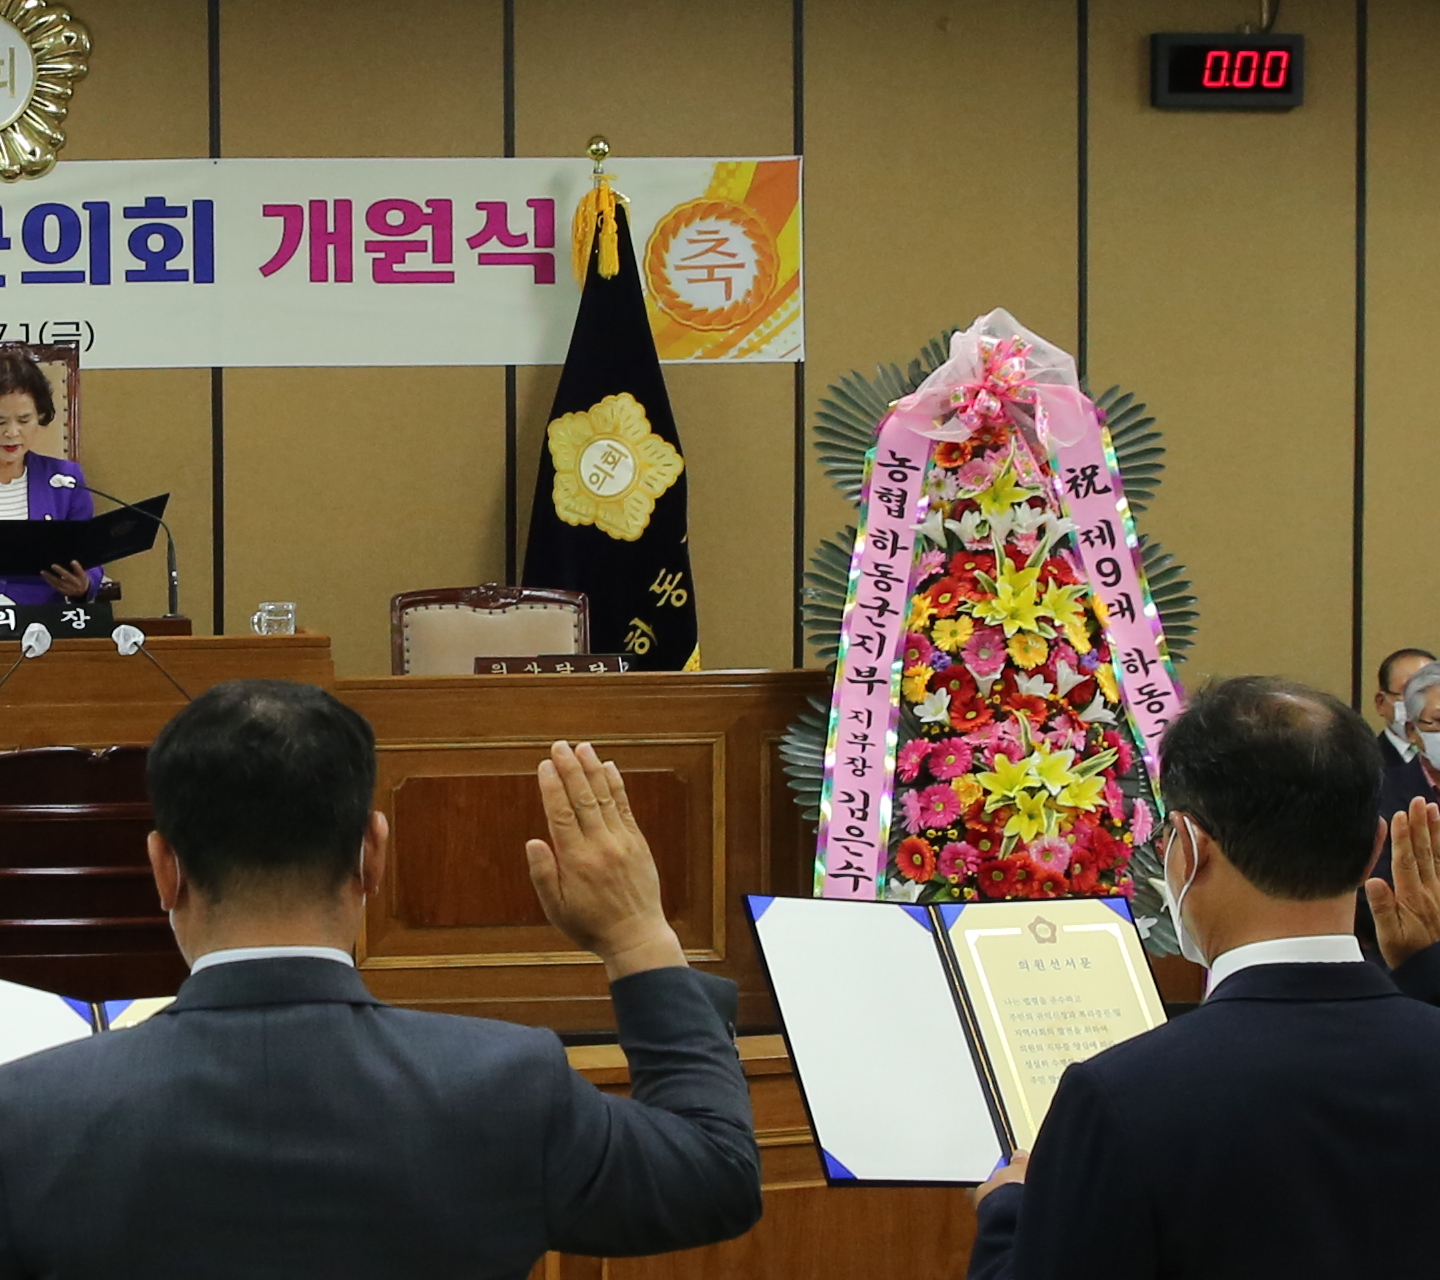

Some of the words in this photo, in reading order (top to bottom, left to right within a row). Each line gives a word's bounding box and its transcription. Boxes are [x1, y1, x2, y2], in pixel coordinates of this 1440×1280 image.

[1202, 50, 1289, 89] 0.00
[258, 197, 557, 286] 개원식
[672, 228, 747, 303] 축
[589, 443, 628, 491] 의회
[875, 450, 921, 519] 농협
[1065, 464, 1112, 499] 祝
[1080, 519, 1136, 624] 제9대
[846, 528, 910, 696] 하동군지부
[844, 708, 876, 778] 지부장
[828, 789, 876, 893] 김은수
[1018, 958, 1092, 971] 의원선서문
